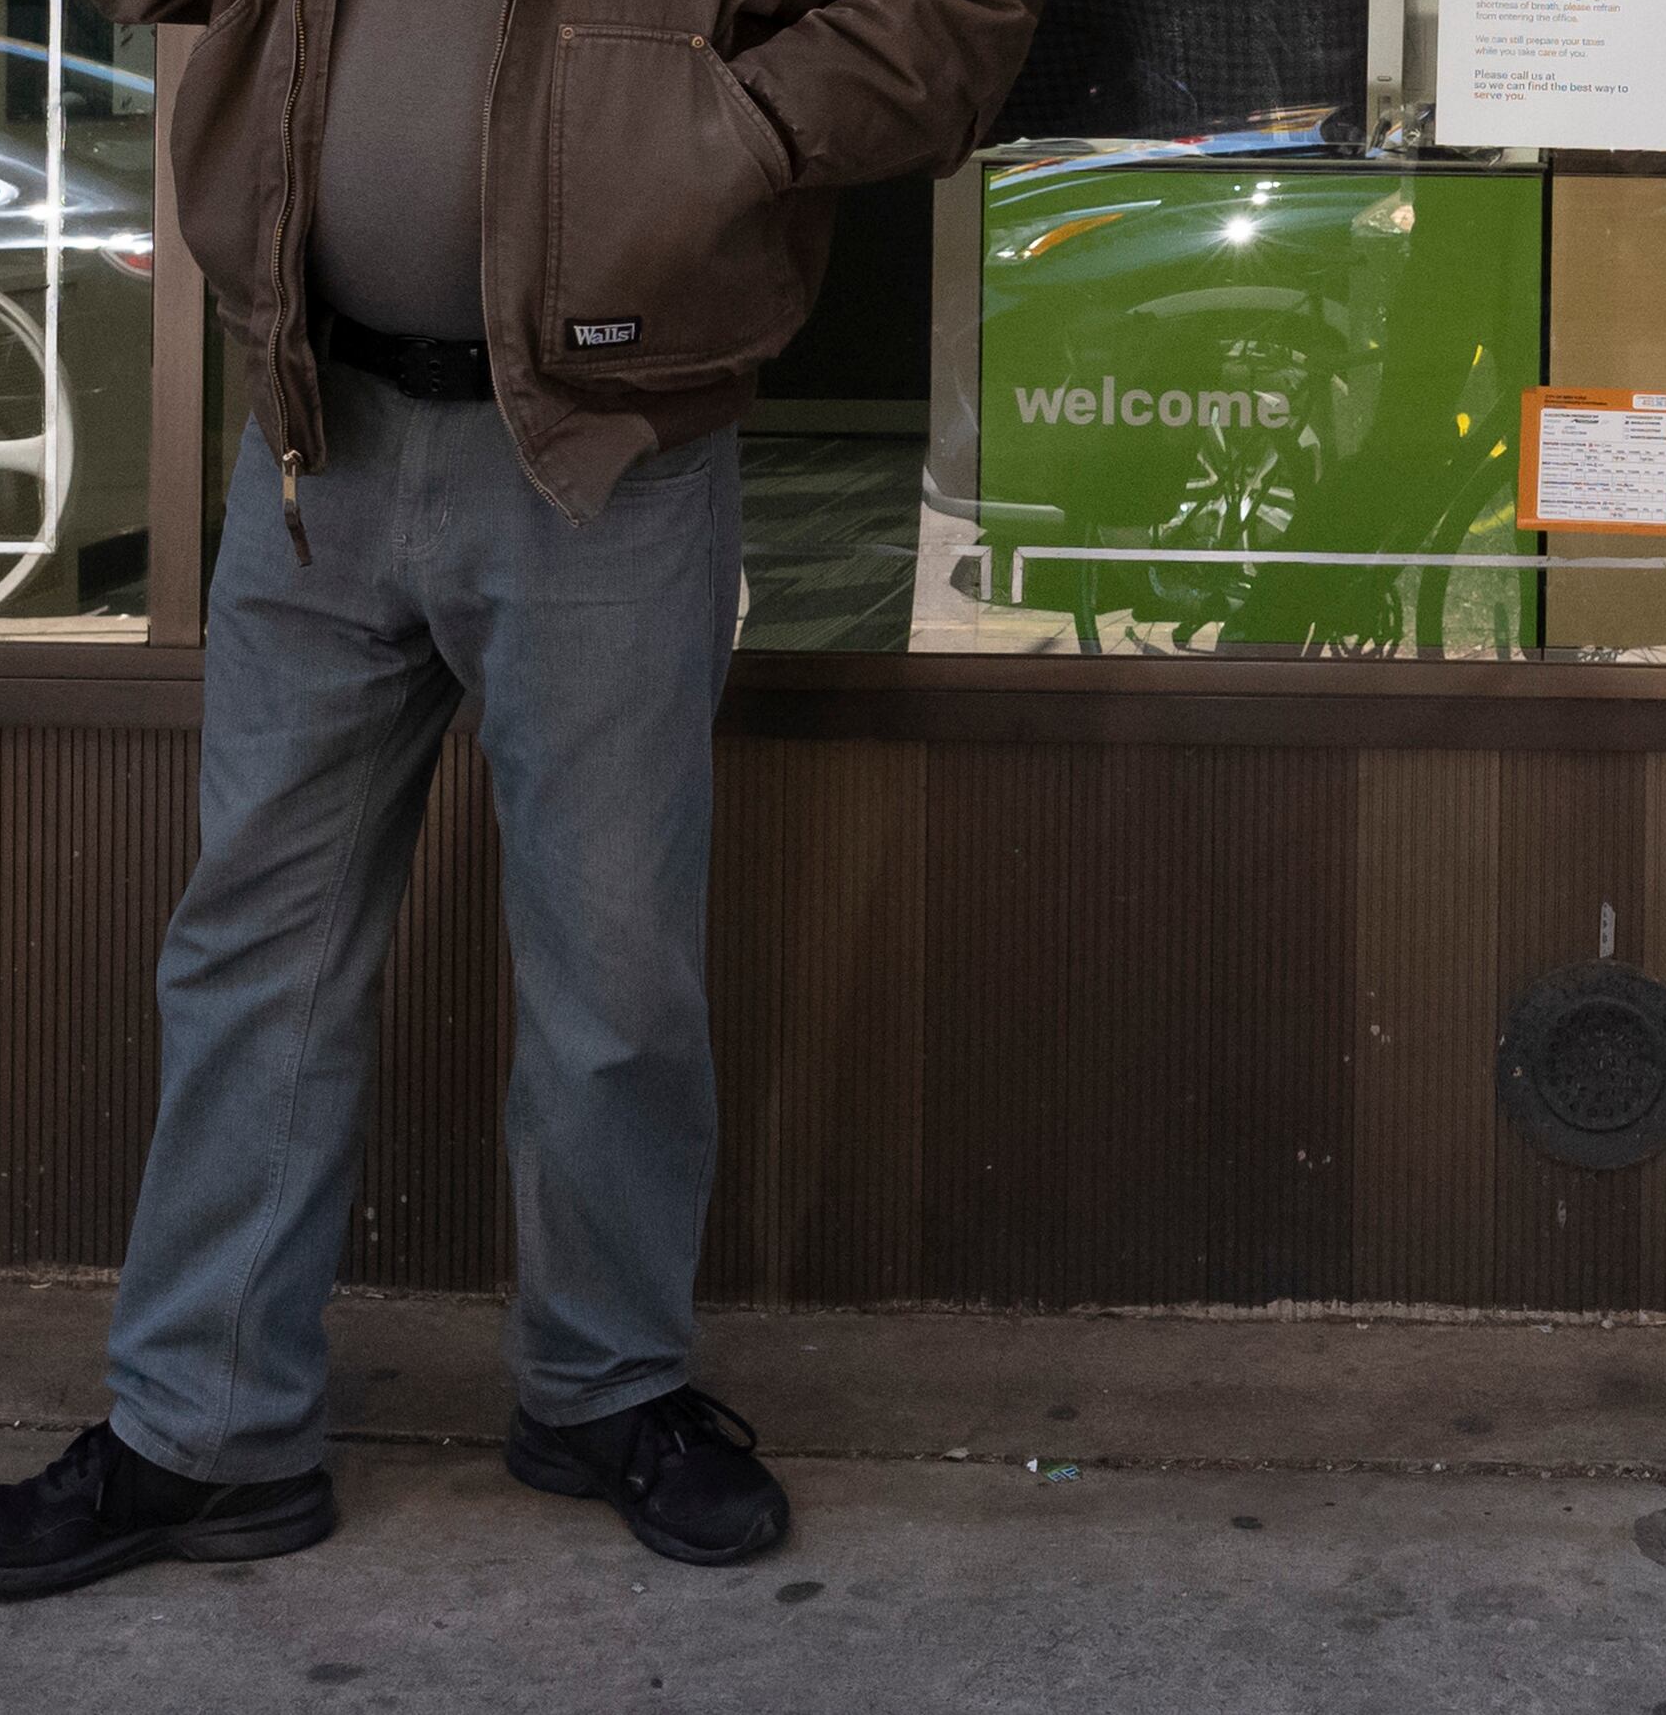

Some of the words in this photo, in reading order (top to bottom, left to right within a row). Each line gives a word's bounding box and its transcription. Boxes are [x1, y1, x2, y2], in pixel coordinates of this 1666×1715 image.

[1563, 3, 1591, 12] please
[1592, 4, 1620, 12] refrain
[1476, 11, 1497, 20] from
[1498, 13, 1534, 22] entering
[1536, 13, 1551, 21] the
[1475, 35, 1490, 43] We
[1491, 36, 1507, 44] can
[1509, 35, 1524, 44] still
[1526, 37, 1559, 46] prepare
[1561, 38, 1580, 47] your
[1499, 48, 1516, 56] you
[1538, 49, 1557, 57] care
[1558, 49, 1568, 57] of
[1474, 70, 1508, 79] Please
[1510, 71, 1529, 80] call
[1545, 73, 1556, 81] at
[1474, 81, 1486, 89] so
[1488, 82, 1504, 90] we
[1527, 82, 1548, 91] find
[1550, 83, 1568, 92] the
[1569, 83, 1592, 93] best
[1594, 85, 1616, 94] way
[1618, 85, 1629, 94] to
[1505, 92, 1527, 101] you.
[573, 323, 635, 345] Walls
[1014, 376, 1292, 429] welcome
